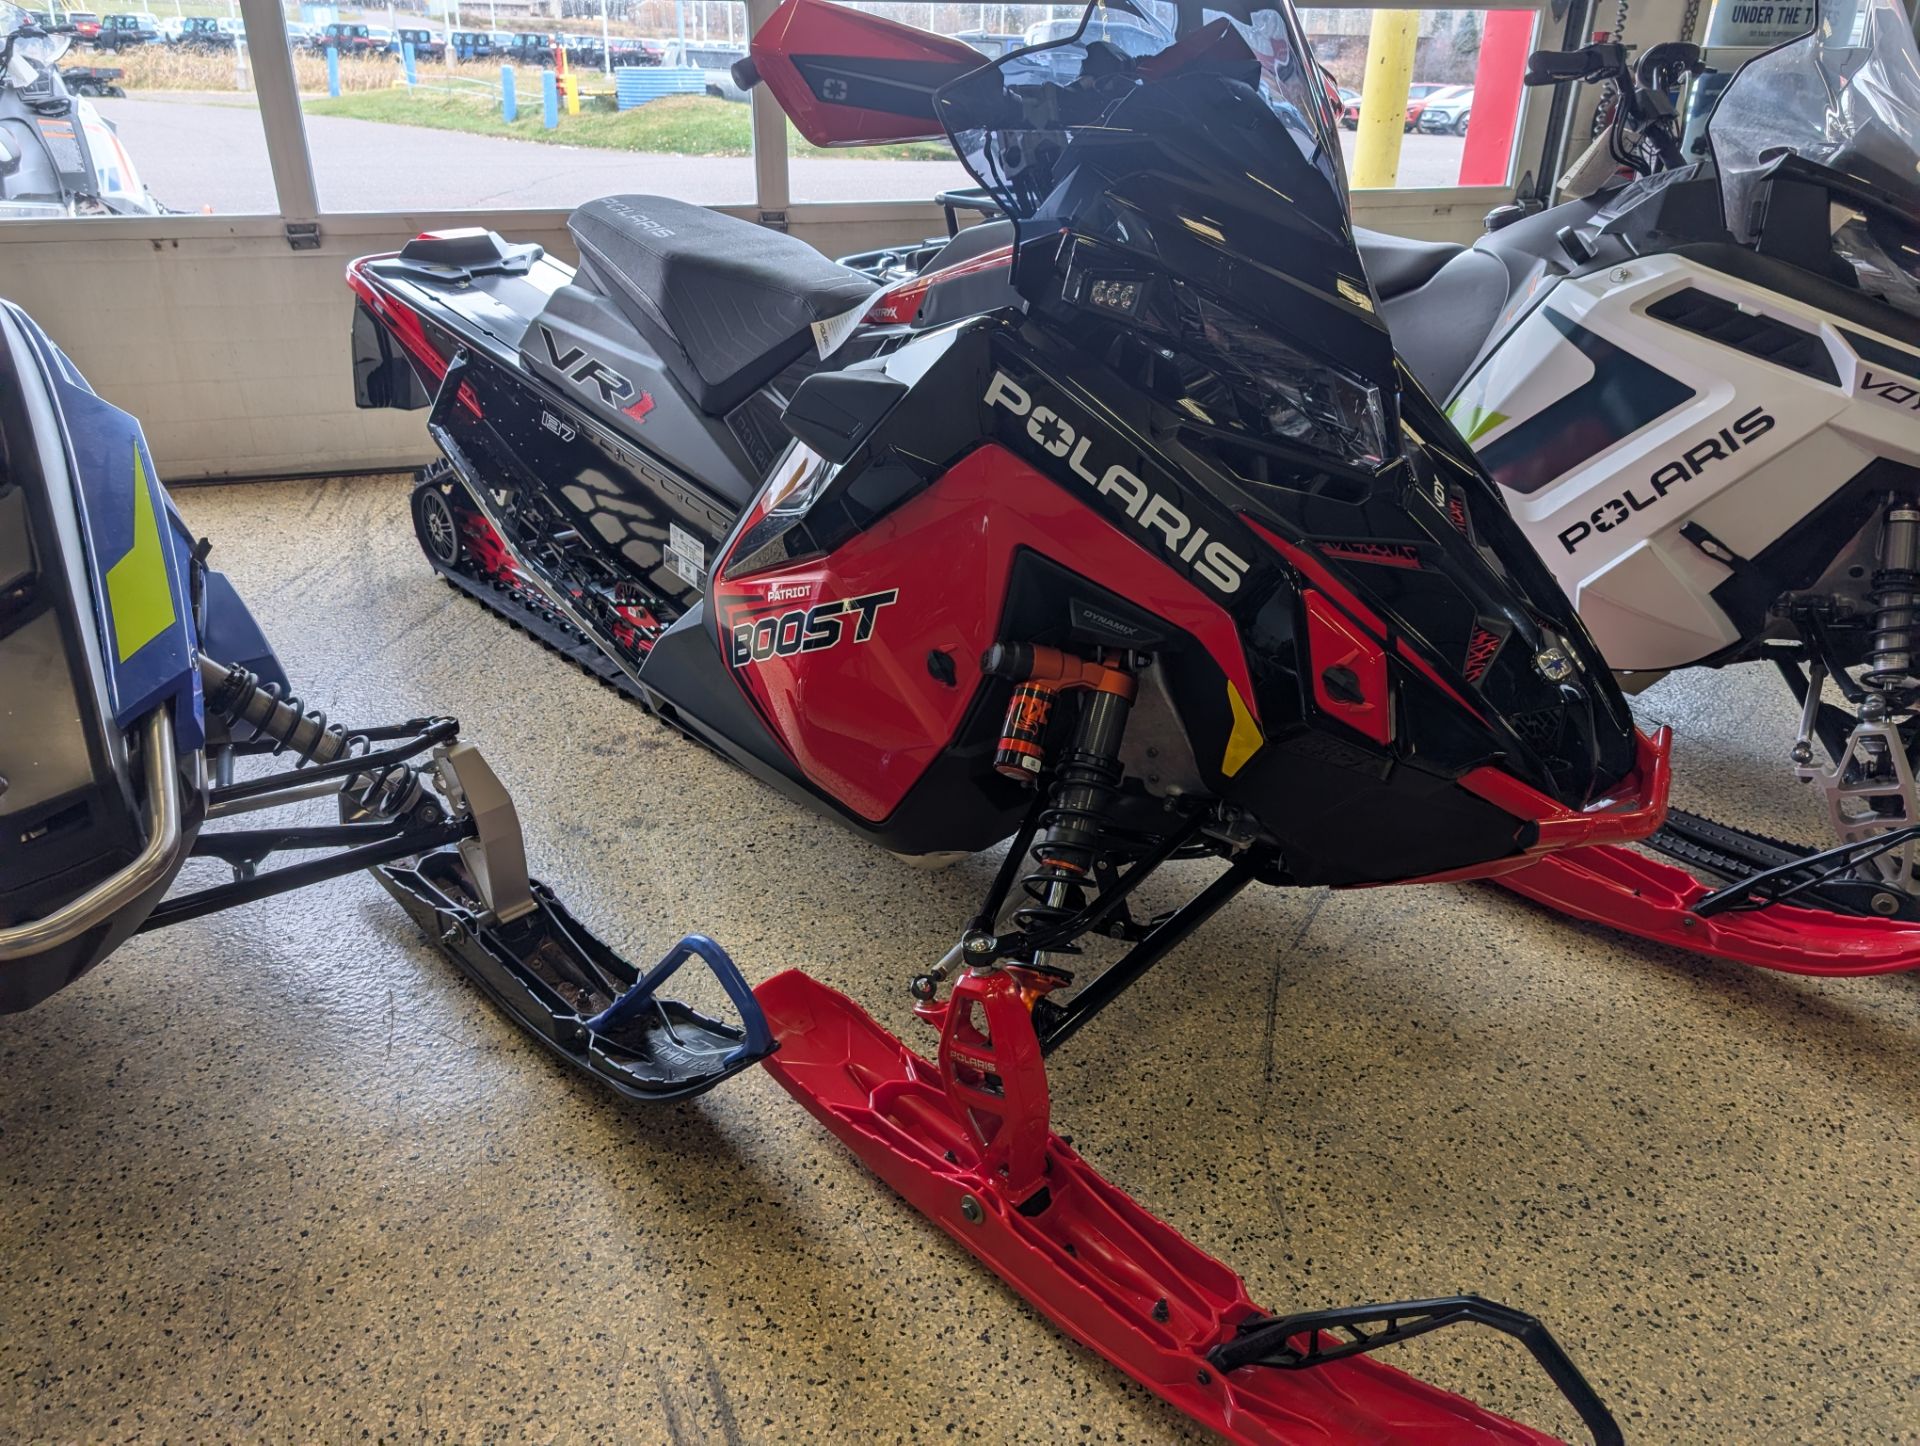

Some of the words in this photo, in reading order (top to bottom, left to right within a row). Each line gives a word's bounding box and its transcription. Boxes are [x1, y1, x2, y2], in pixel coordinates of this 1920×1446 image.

[1732, 5, 1773, 24] UNDER
[1778, 6, 1802, 24] THE
[601, 198, 676, 238] POLARIS
[539, 323, 656, 425] VR1
[983, 370, 1250, 594] POLARIS
[1557, 406, 1776, 555] POLARIS
[767, 585, 812, 603] PATRIOT
[733, 587, 900, 668] BOOST
[1083, 609, 1139, 636] DYNAMIX
[950, 1050, 997, 1073] POLARIS
